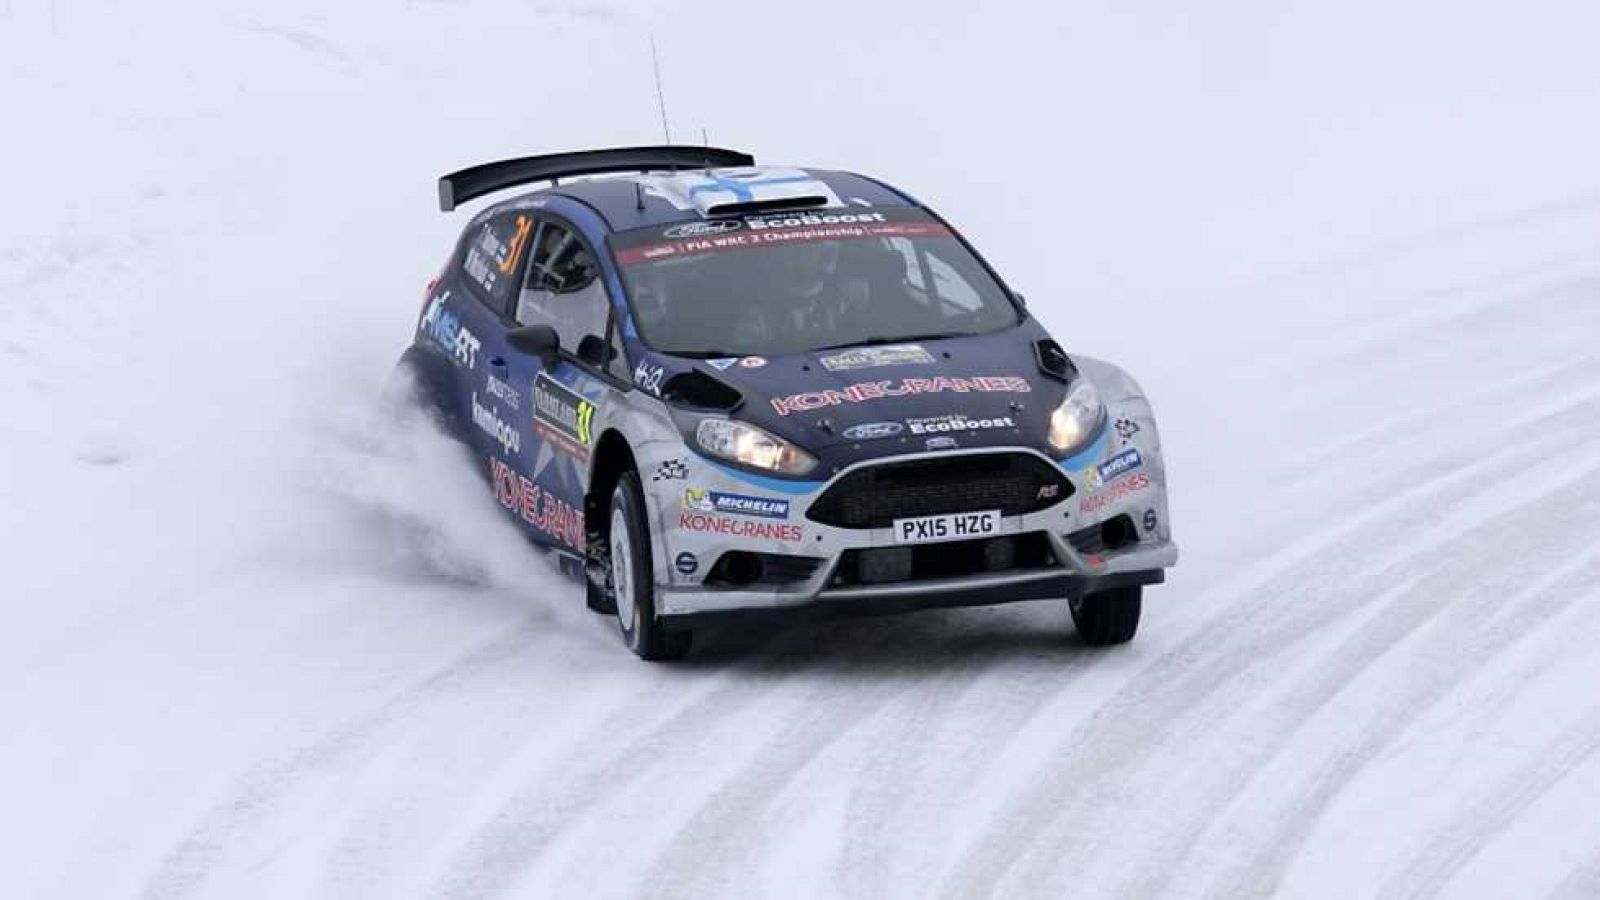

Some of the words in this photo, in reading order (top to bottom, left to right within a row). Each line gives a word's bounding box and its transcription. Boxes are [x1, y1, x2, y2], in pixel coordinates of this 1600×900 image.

[747, 212, 886, 230] EcoBoost
[497, 213, 535, 276] 31
[686, 241, 712, 251] FIA
[715, 237, 749, 247] WRC
[763, 227, 864, 242] Championship
[769, 376, 1032, 416] KONECRANES
[909, 416, 1016, 434] EcoBoost
[716, 496, 787, 514] MICHELIN
[679, 512, 803, 542] KONECRANES
[903, 518, 948, 540] PX15
[954, 514, 993, 535] HZG
